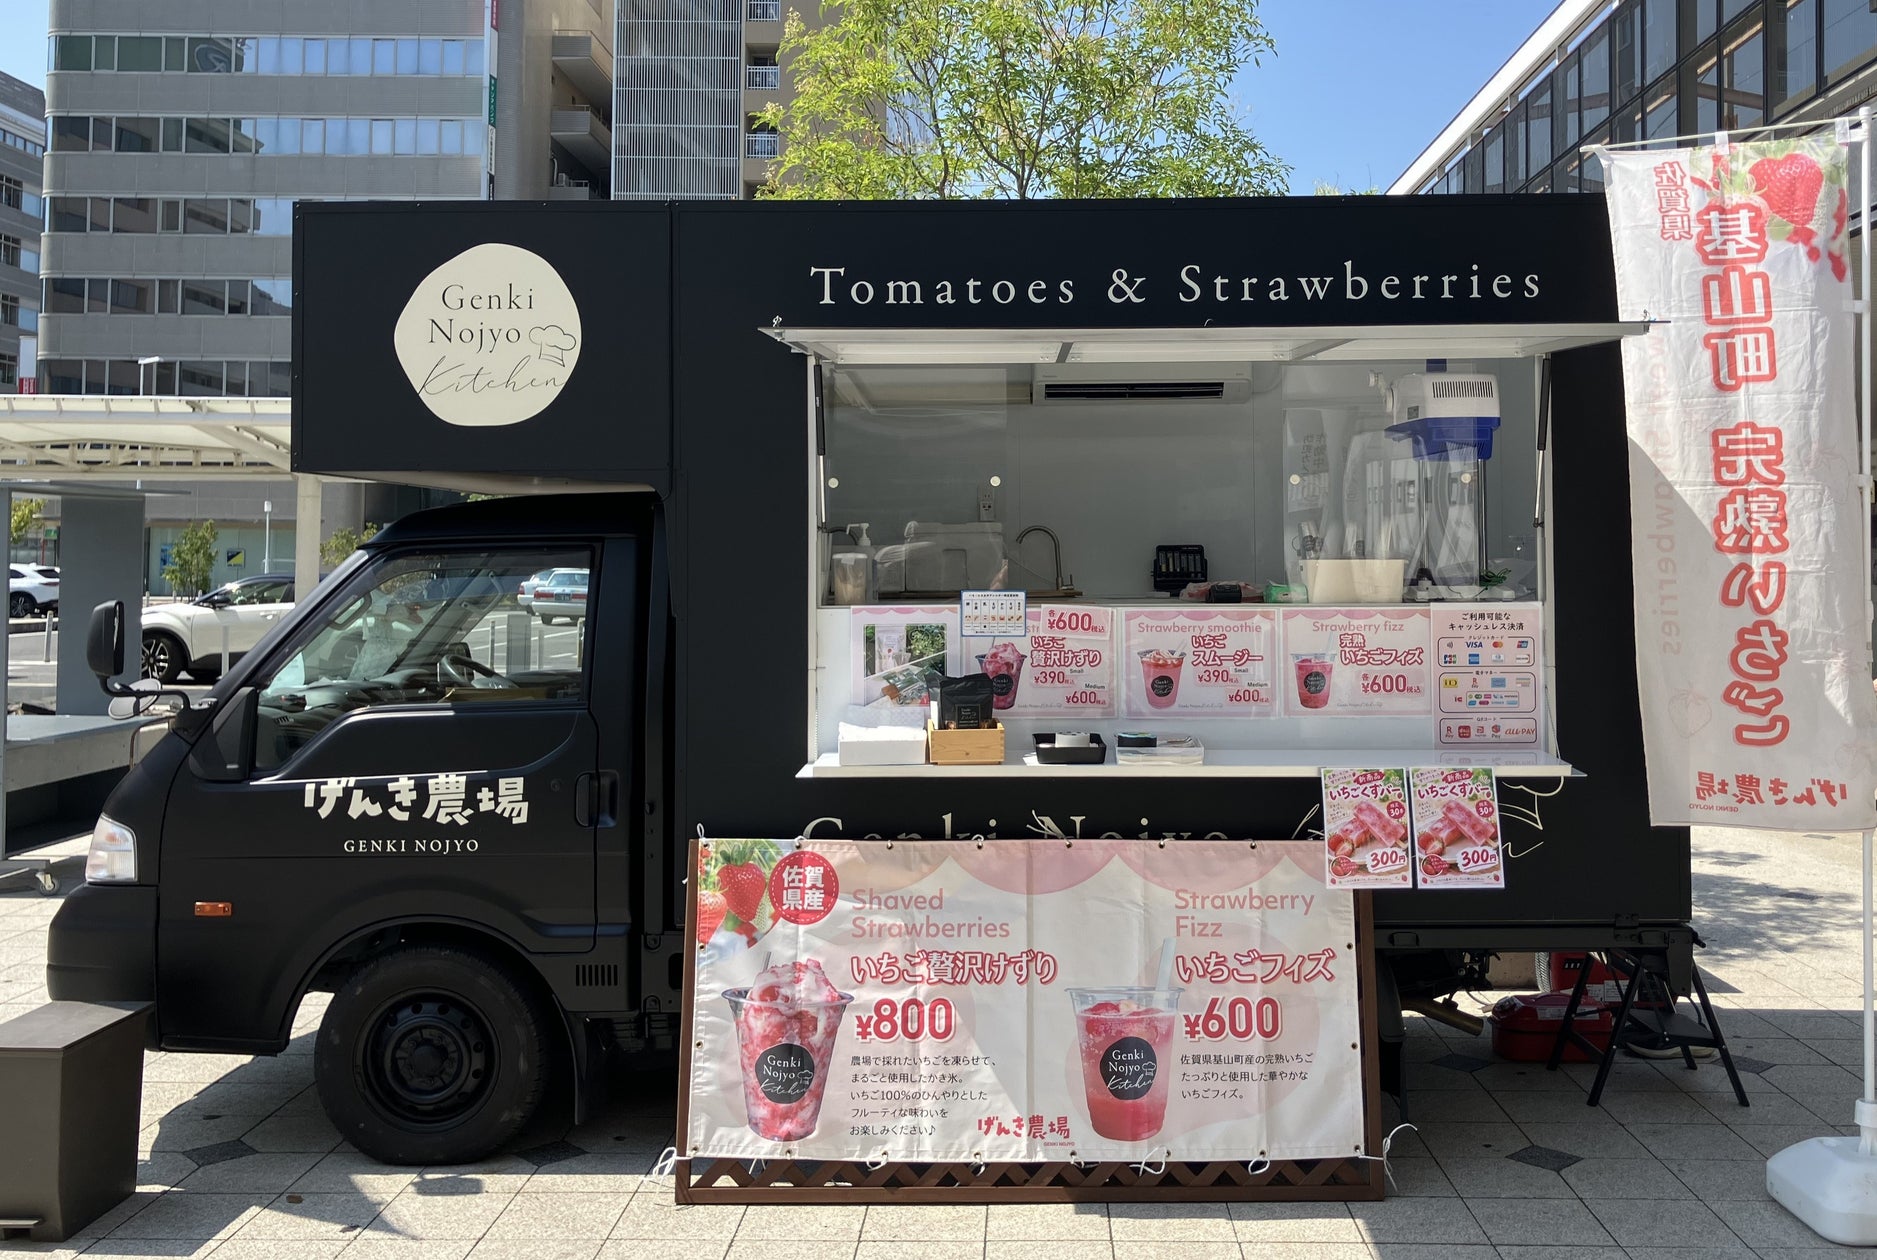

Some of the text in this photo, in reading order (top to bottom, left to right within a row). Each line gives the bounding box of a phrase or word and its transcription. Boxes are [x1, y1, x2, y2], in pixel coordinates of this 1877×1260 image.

[810, 260, 1540, 305] Tomatoes & Strawberries
[441, 283, 534, 311] Genki
[428, 318, 521, 353] Nojyo
[417, 355, 566, 396] Kitchen
[1461, 612, 1511, 621] ご利用可能な
[1138, 622, 1262, 634] Strawberry smoothie
[1312, 621, 1405, 634] Strawberry fizz
[1448, 622, 1525, 631] キャッシュレス決済
[1191, 634, 1227, 648] いちご
[1339, 633, 1366, 648] 完熟
[1031, 649, 1102, 667] 贅沢けずり
[1191, 648, 1263, 666] スムージー
[1340, 647, 1424, 666] いちごフィズ
[1329, 783, 1401, 801] いちごくずバー
[1417, 782, 1490, 799] いちごくずバー
[304, 774, 529, 826] げんき農場
[344, 840, 479, 855] GENKI NOJYO
[782, 865, 825, 888] 佐賀
[782, 889, 825, 911] 県産
[852, 888, 944, 910] Shaved
[1174, 888, 1315, 915] Strawberry
[851, 915, 1010, 938] Strawberries
[1175, 916, 1223, 938] Fizz
[850, 948, 1059, 986] いちご贅沢けずり
[1175, 947, 1337, 984] いちごフィズ
[855, 997, 954, 1041] ¥800
[1183, 997, 1280, 1040] ¥600
[767, 1055, 801, 1067] Genki
[1112, 1049, 1144, 1061] Genki
[1180, 1053, 1314, 1065] 佐賀県基山町産の完熟いちご
[763, 1064, 796, 1082] Nojyo
[1108, 1062, 1140, 1075] Nojyo
[1181, 1071, 1309, 1082] たっぷりと使用した華やかな
[850, 1073, 963, 1084] まるごと使用したかき氷。
[850, 1090, 988, 1101] いちご100%のひんやりとした
[1181, 1088, 1244, 1100] いちごフィズ。
[850, 1108, 949, 1119] フルーティな味わいを
[977, 1115, 1071, 1140] げんき農場
